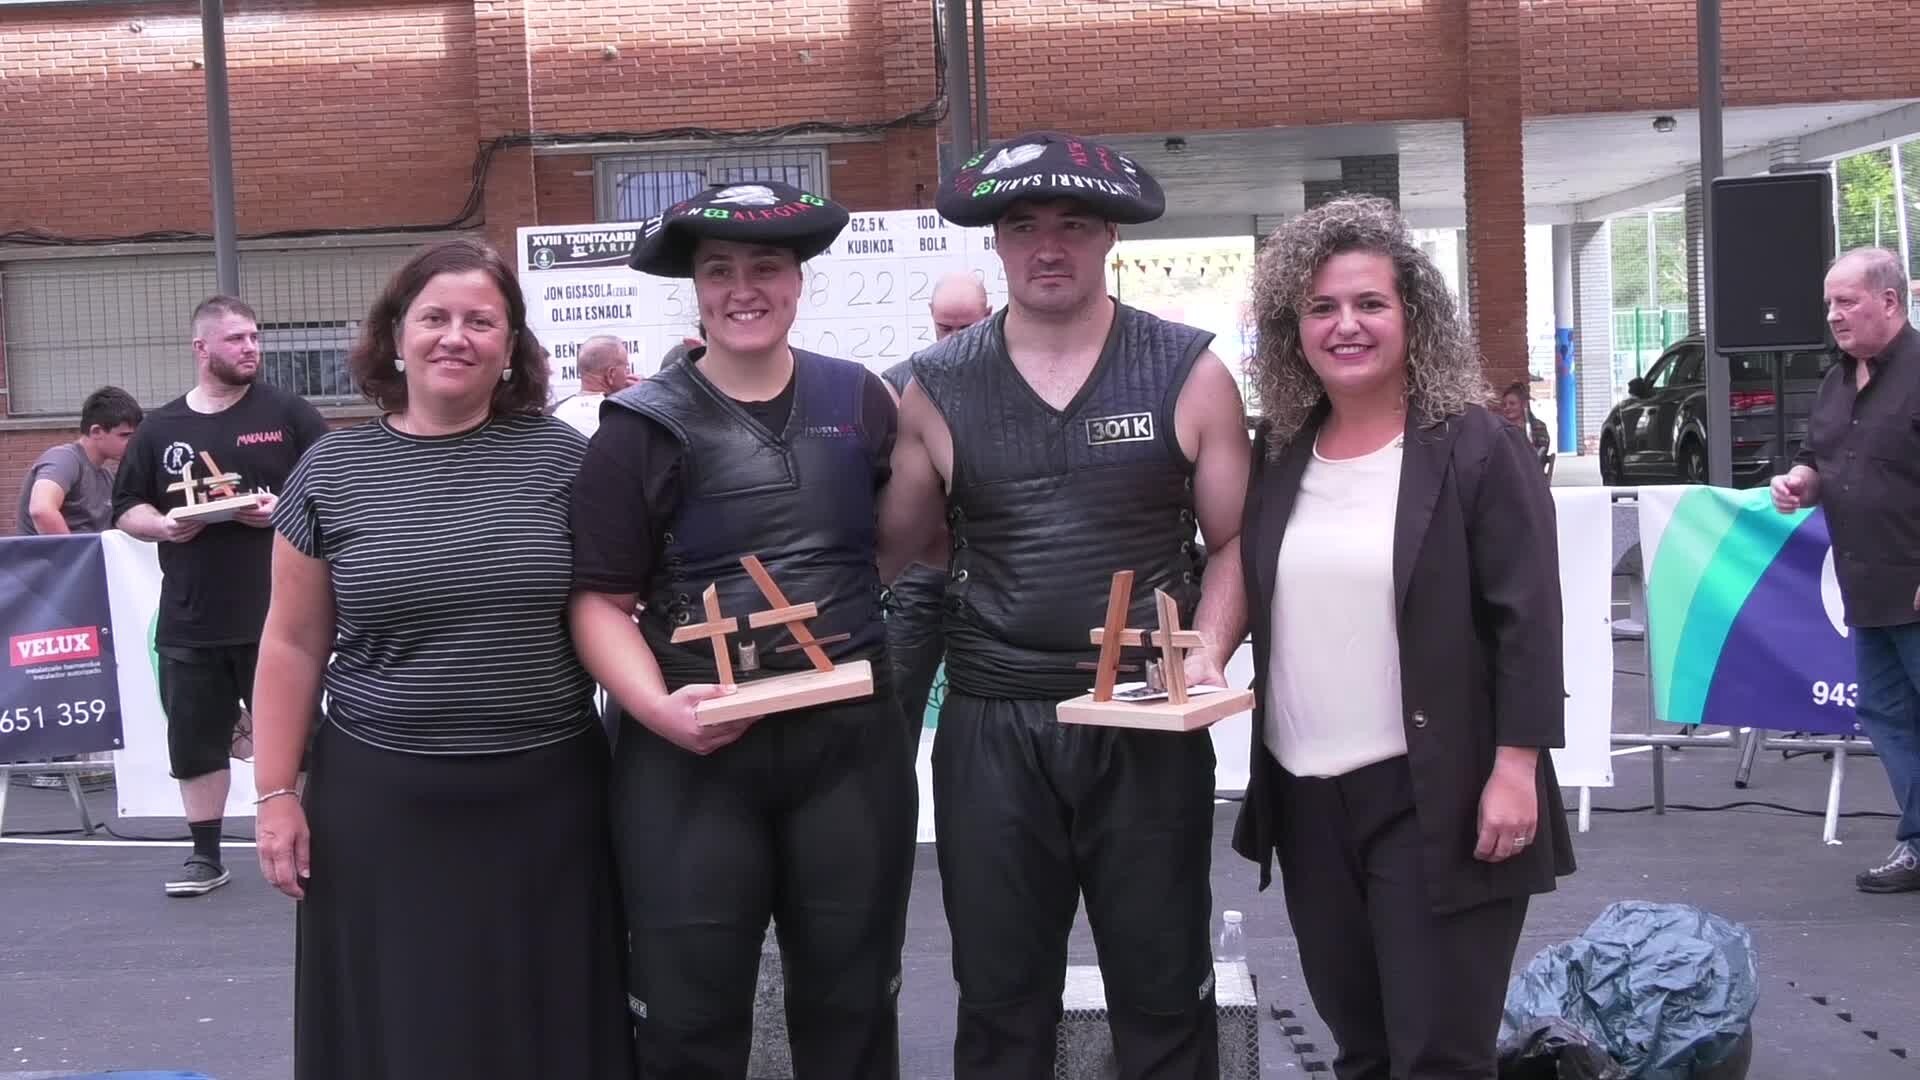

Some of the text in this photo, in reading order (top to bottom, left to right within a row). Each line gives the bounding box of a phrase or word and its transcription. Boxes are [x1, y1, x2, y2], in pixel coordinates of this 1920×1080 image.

[878, 216, 888, 231] K.
[917, 215, 936, 230] 100
[532, 231, 637, 246] XVIII TXINTXARRI
[919, 237, 947, 251] BOLA
[847, 239, 894, 254] KUBIKOA
[544, 286, 563, 301] JON
[552, 304, 632, 322] OLAIA ESNAOLA
[17, 633, 91, 659] VELUX
[0, 699, 106, 733] 651 359
